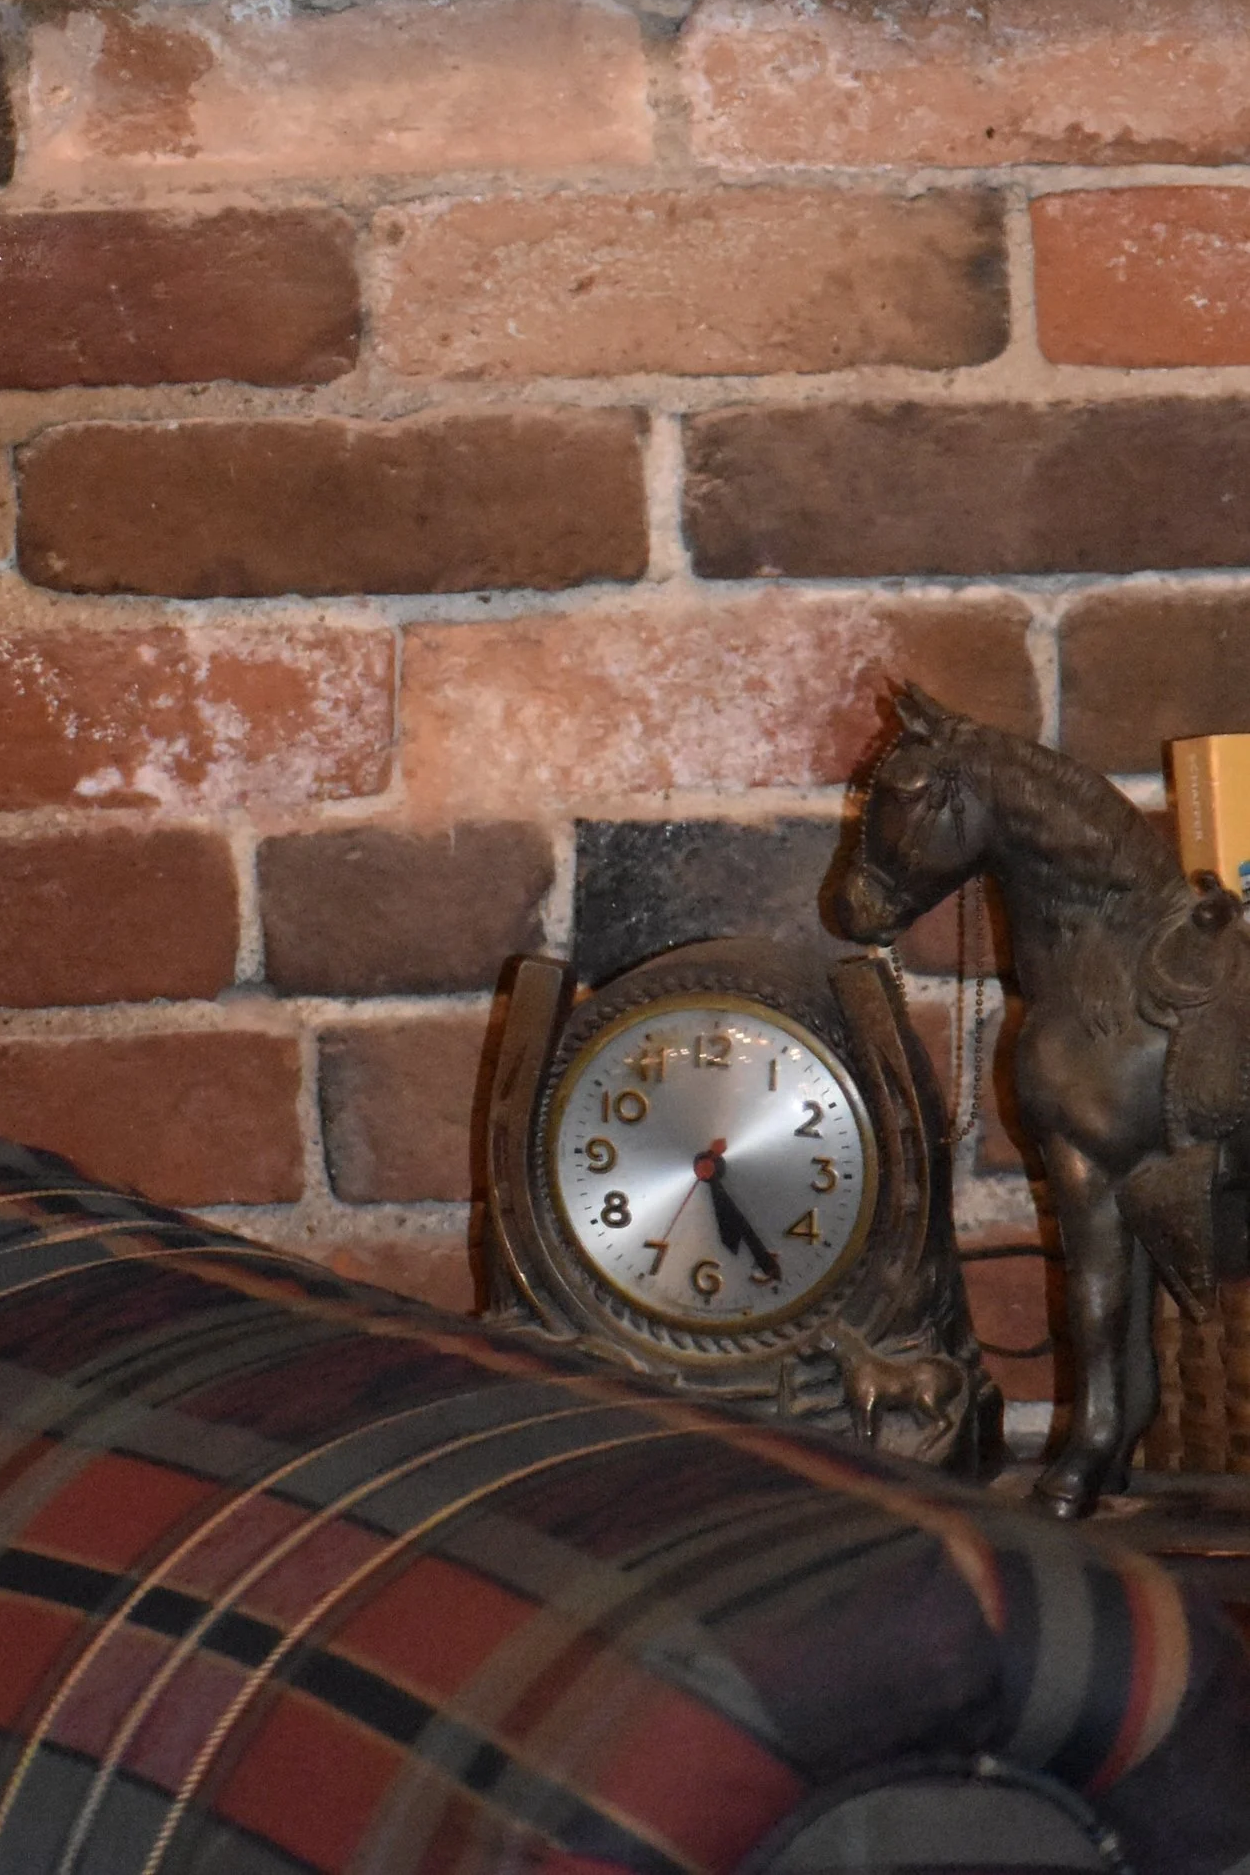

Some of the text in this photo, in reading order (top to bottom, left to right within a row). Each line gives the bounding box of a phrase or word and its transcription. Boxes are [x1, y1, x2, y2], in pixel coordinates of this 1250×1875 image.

[693, 1034, 733, 1069] 12
[767, 1057, 778, 1092] 1
[601, 1088, 649, 1124] 10
[793, 1099, 824, 1138] 2
[585, 1135, 618, 1174] 9
[810, 1154, 839, 1194] 3
[600, 1189, 632, 1229] 8
[783, 1206, 823, 1246] 4
[643, 1239, 670, 1276] 7
[692, 1258, 723, 1296] 6
